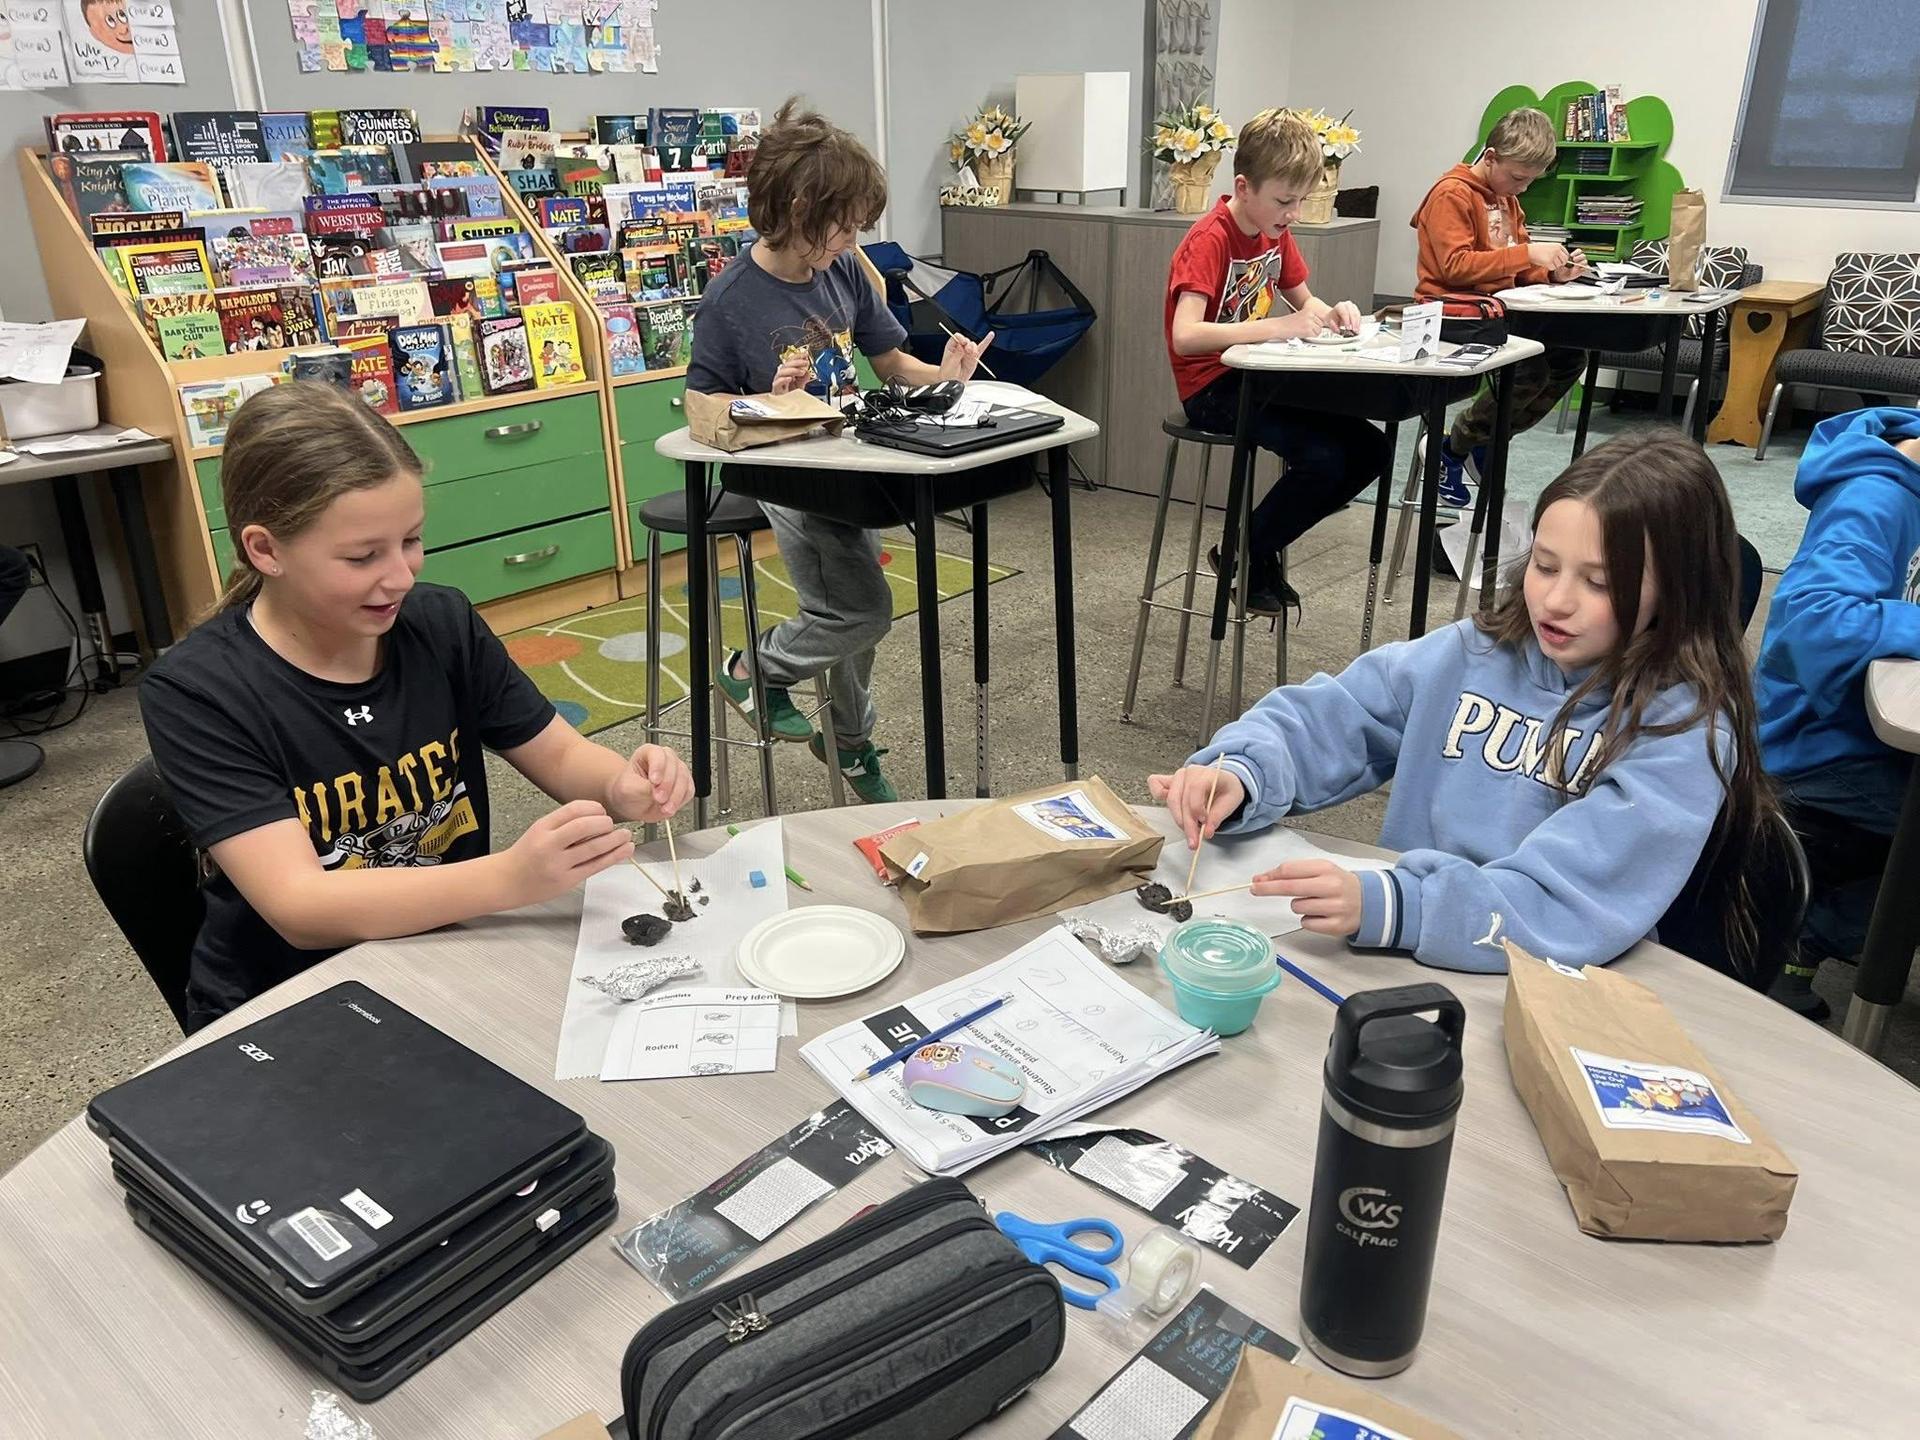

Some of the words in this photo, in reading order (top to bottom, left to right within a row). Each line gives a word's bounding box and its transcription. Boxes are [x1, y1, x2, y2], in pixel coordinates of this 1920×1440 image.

[358, 118, 411, 130] GUINNESS
[359, 130, 413, 145] WORLD
[507, 139, 525, 150] Ruby
[528, 141, 555, 152] Bridges
[702, 138, 727, 155] Earth
[668, 147, 681, 169] 7
[76, 166, 103, 178] King
[81, 180, 117, 193] Knight
[697, 187, 733, 199] GALLIPOLI
[149, 194, 192, 208] Planet
[637, 192, 655, 204] Crazy
[657, 192, 666, 201] for
[319, 211, 382, 227] WEBSTER'S
[550, 209, 581, 223] NATE
[95, 218, 181, 234] HOCKEY
[134, 262, 201, 277] DINOSAURS
[321, 257, 349, 275] JAK
[220, 291, 277, 310] NAPOLEON'S
[356, 291, 376, 300] The
[380, 287, 418, 300] Pigeon
[230, 309, 247, 317] LAST
[249, 304, 272, 314] STAND
[649, 307, 683, 325] Reptiles
[532, 314, 570, 328] NATE
[658, 321, 684, 334] Insects
[164, 325, 219, 337] BABY-SITTERS
[183, 333, 204, 341] CLUB
[348, 1002, 381, 1025] chromebook
[993, 1029, 1015, 1049] value.
[239, 1042, 275, 1062] acer
[645, 1043, 679, 1051] Rodent
[991, 1044, 1021, 1066] analyze
[1014, 1047, 1040, 1063] place
[1021, 1064, 1057, 1095] Students
[355, 1200, 381, 1219] CLAIRE
[1335, 1222, 1399, 1248] CALFRAC
